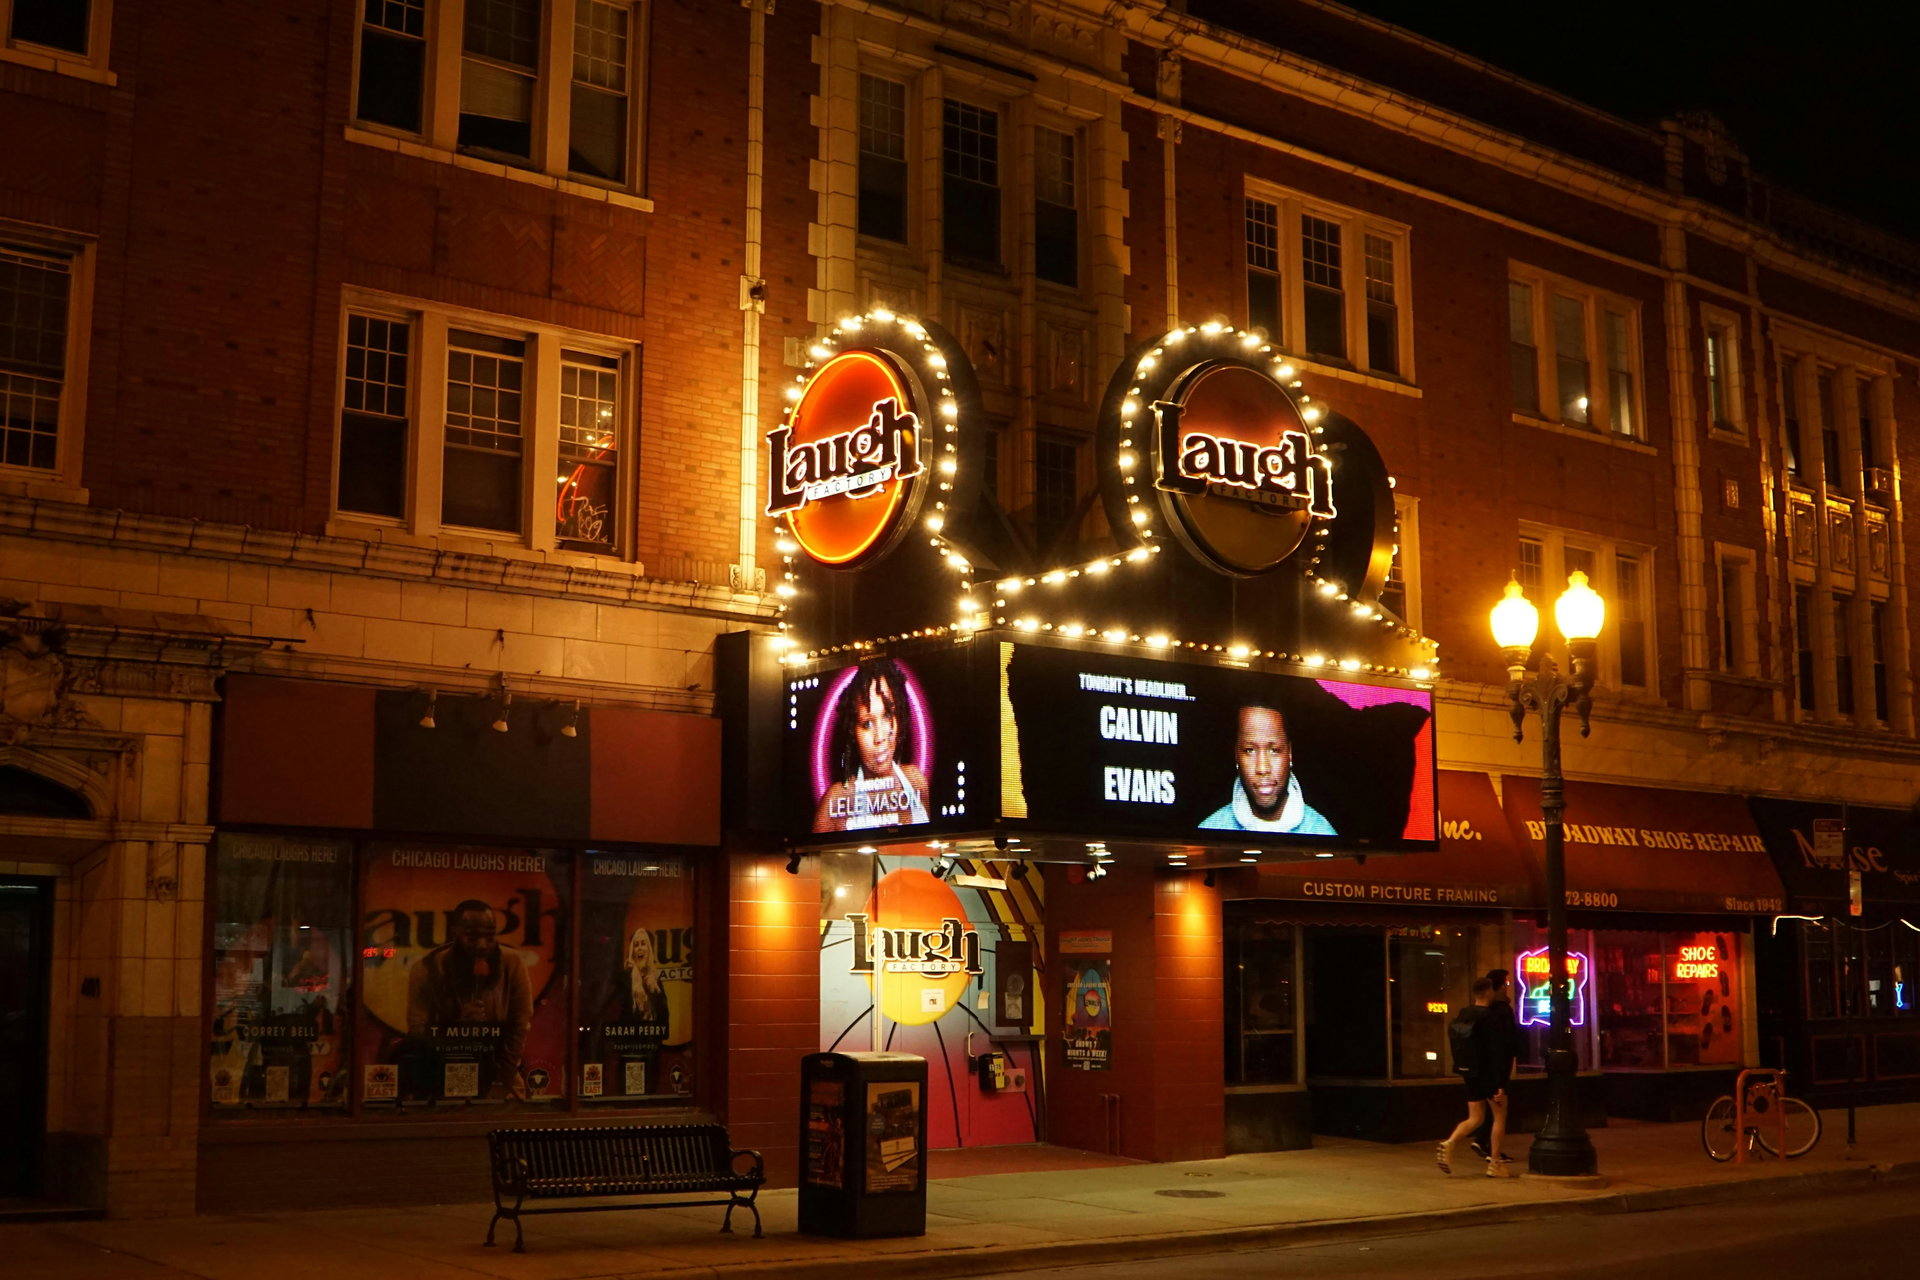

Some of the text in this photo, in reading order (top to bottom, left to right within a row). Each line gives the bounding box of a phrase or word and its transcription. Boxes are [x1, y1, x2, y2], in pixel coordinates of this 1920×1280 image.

[766, 396, 924, 516] Laugh
[1153, 400, 1337, 519] Laugh
[813, 470, 888, 498] FACTORY
[1220, 485, 1301, 509] FACTORY
[1078, 672, 1132, 695] TONIGHT'S
[1099, 705, 1178, 745] CALVIN
[1104, 765, 1176, 805] EVANS
[828, 789, 921, 818] LELE MASON
[1640, 829, 1694, 850] SHOE
[1694, 833, 1766, 853] REPAIR
[391, 849, 546, 873] CHICAGO LAUGHS HERE!
[593, 859, 627, 877] CHICAGO
[1303, 882, 1498, 903] CUSTOM PICTURE FRAMING
[1725, 896, 1783, 912] Since 1942
[845, 913, 984, 979] Laugh
[1681, 946, 1716, 962] SHOE
[892, 963, 957, 972] FACTORY
[1676, 963, 1719, 979] REPAIRS
[290, 1025, 315, 1038] BELL
[430, 1026, 501, 1038] T MURPH
[604, 1025, 667, 1037] SARAH PERRY
